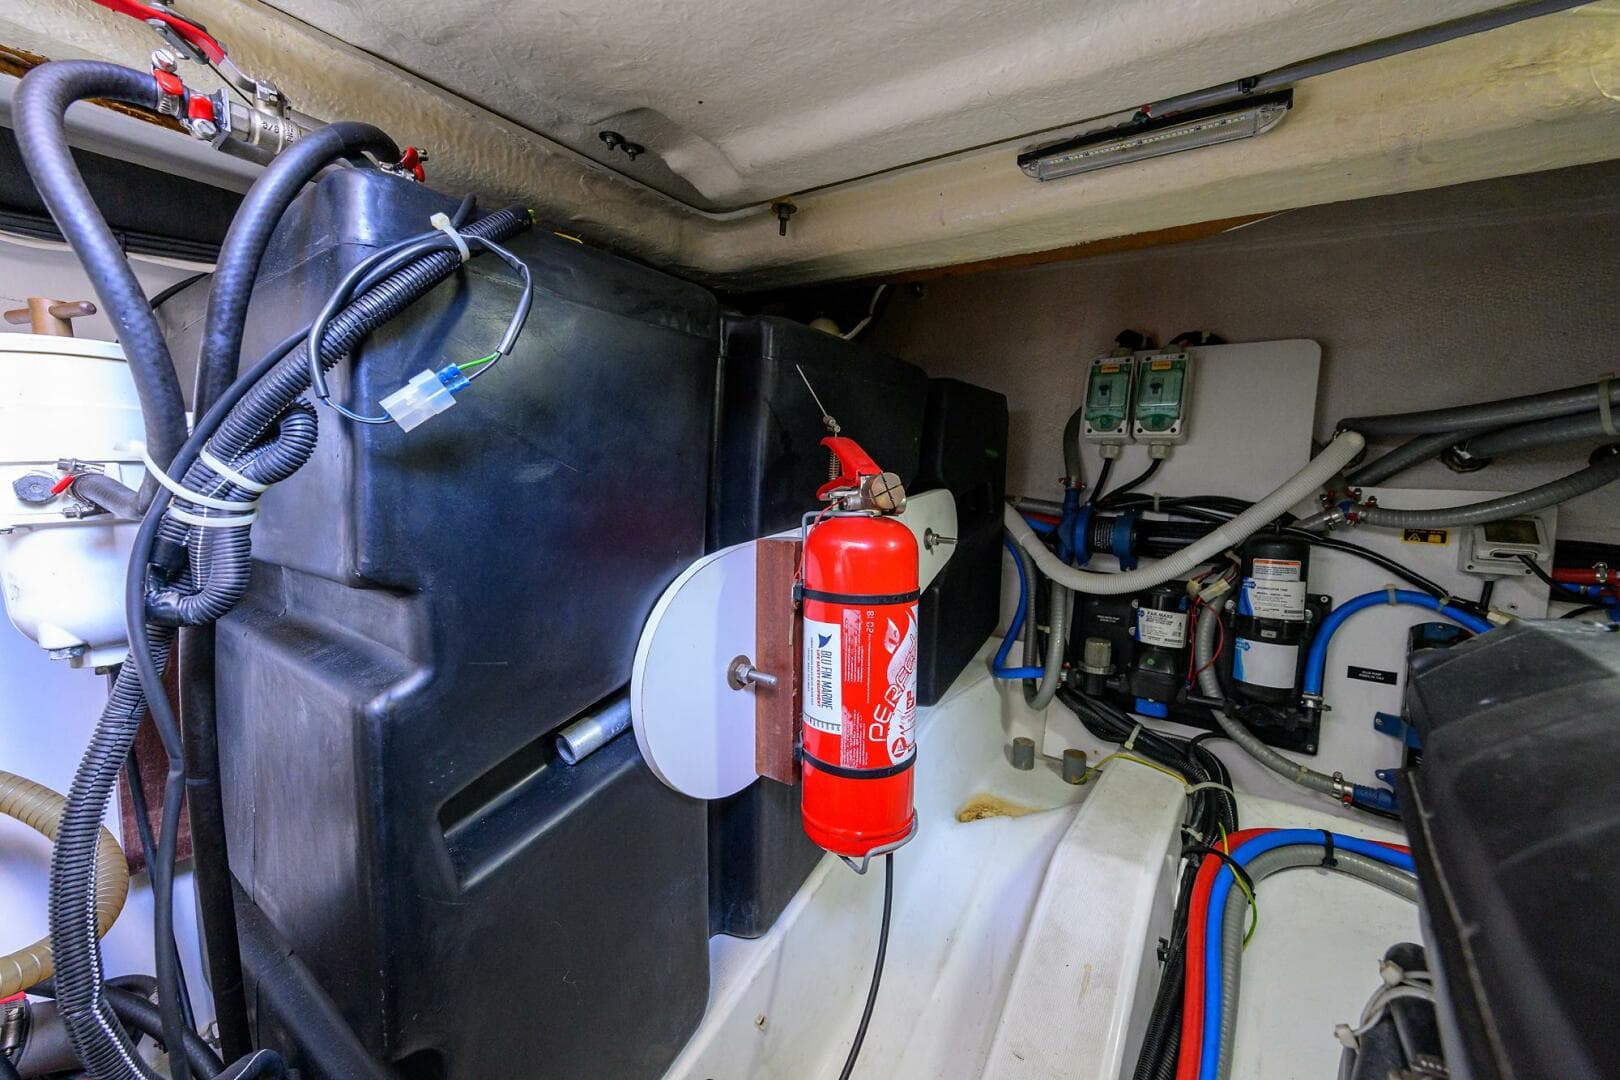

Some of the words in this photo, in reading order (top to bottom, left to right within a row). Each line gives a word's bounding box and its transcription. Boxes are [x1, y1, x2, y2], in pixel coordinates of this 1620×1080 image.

[821, 649, 833, 667] BLU
[821, 668, 833, 680] FIN
[821, 680, 833, 711] MARINE
